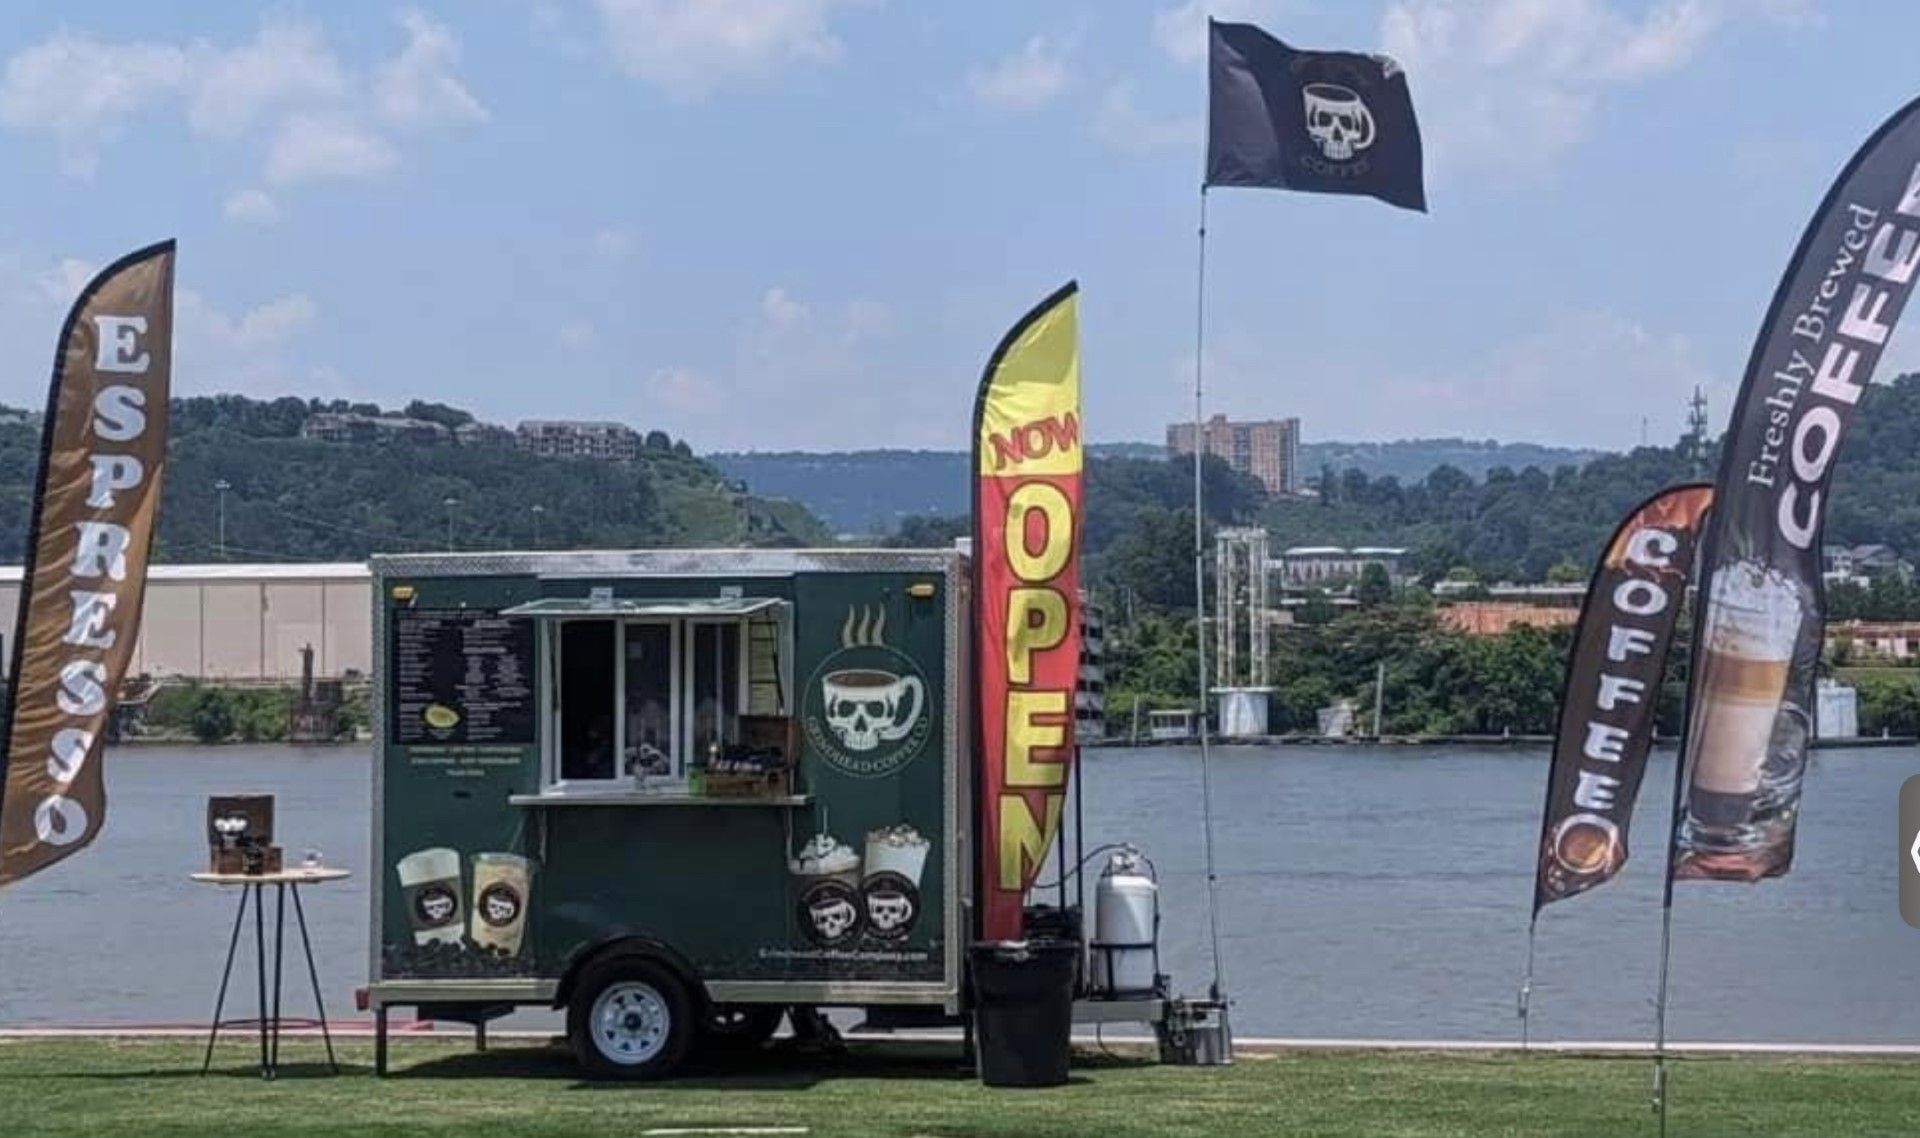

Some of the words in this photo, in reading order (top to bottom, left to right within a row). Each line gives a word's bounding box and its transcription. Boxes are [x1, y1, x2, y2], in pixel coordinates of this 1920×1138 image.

[988, 411, 1078, 471] NOW
[1748, 348, 1816, 488] Freshly
[1792, 203, 1878, 343] Brewed
[1778, 160, 1920, 549] COFFE
[34, 315, 151, 846] ESPRESSO
[999, 480, 1073, 891] OPEN
[1573, 527, 1677, 810] COFFEE
